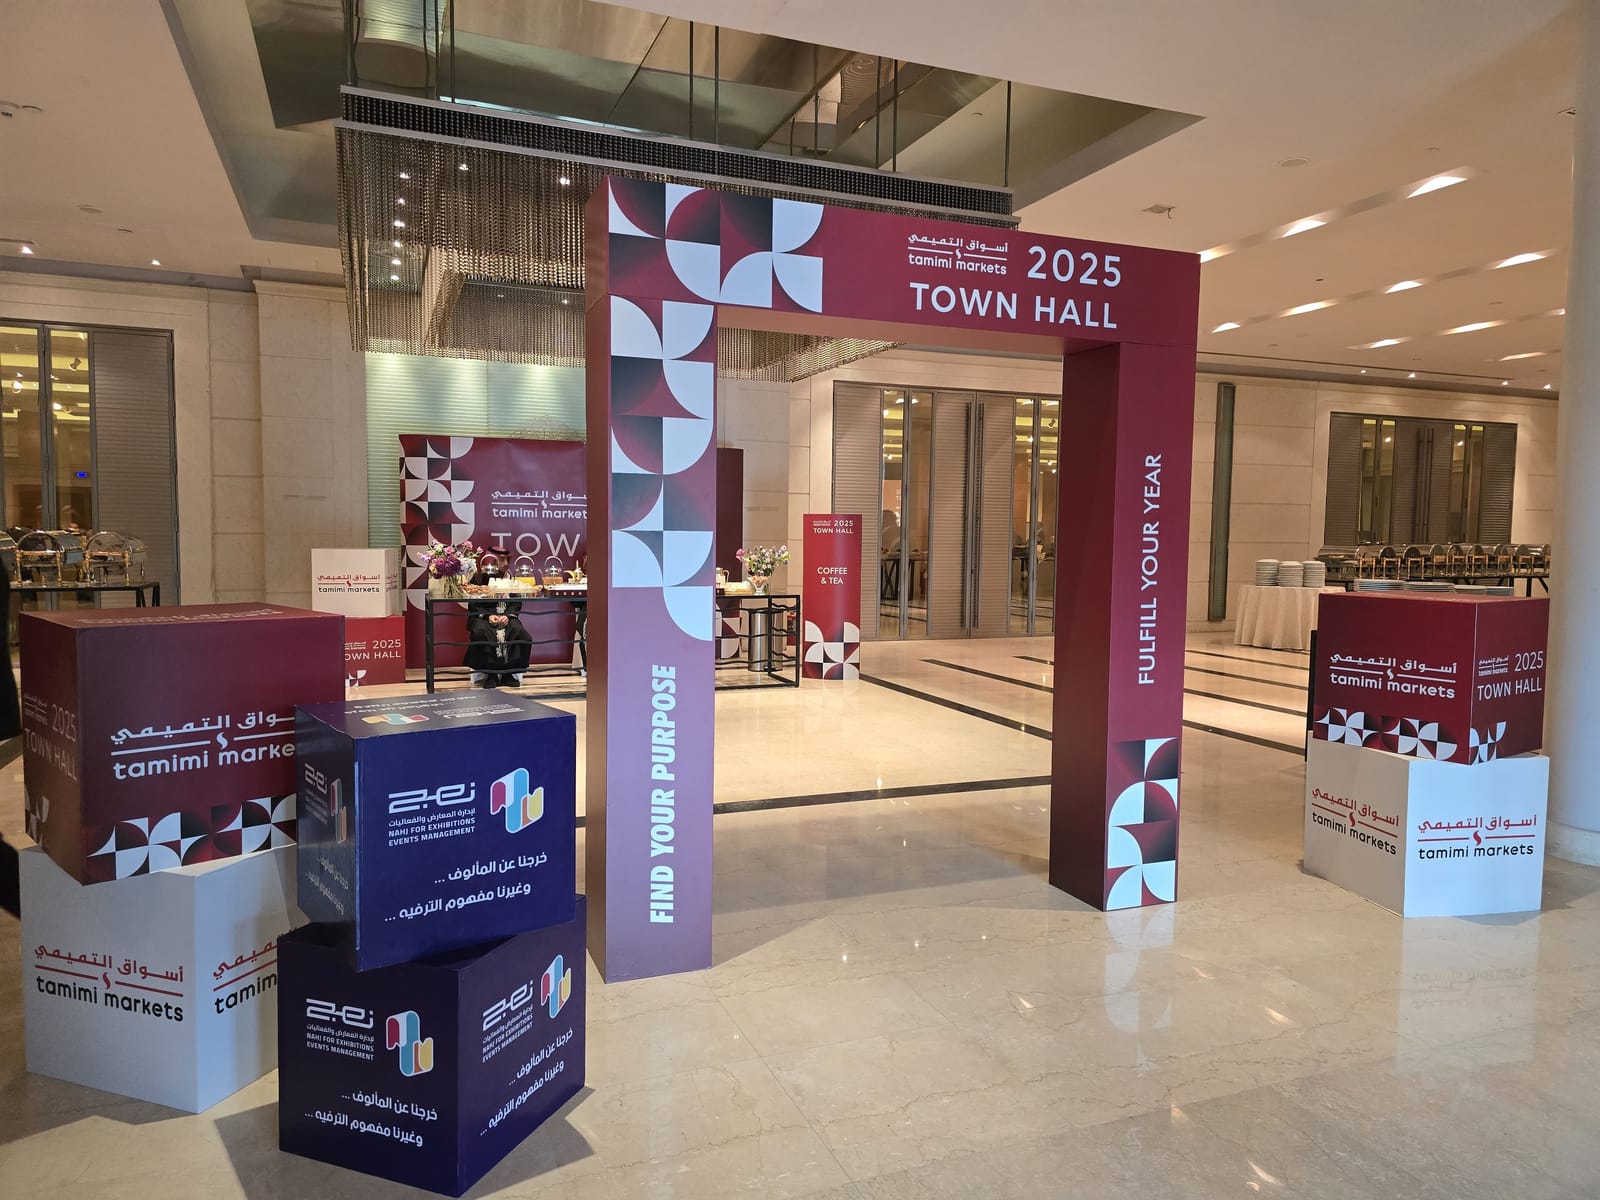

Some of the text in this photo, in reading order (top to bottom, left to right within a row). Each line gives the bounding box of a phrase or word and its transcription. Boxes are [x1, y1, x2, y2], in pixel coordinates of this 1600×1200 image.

[908, 234, 1008, 253] أسواق التميمي
[908, 253, 1007, 275] tamimi markets
[1027, 245, 1121, 288] 2025
[909, 281, 1118, 329] TOWN HALL
[491, 490, 549, 500] التميمي
[492, 507, 588, 520] tamimi market
[490, 532, 581, 557] TOW
[817, 566, 848, 575] COFFEE
[1138, 453, 1162, 685] FULFILL YOUR YEAR
[820, 576, 844, 585] & TEA
[372, 638, 401, 649] 2025
[344, 650, 401, 661] OWN HALL
[1330, 653, 1457, 674] أسواق التميمي
[1514, 650, 1544, 672] 2025
[1330, 672, 1455, 699] tamimi markets
[1477, 677, 1542, 701] TOWN HALL
[52, 703, 77, 742] 2025
[110, 711, 296, 745] واق التميمي
[24, 727, 78, 783] TOWN HALL
[113, 742, 296, 780] tamimi marke
[650, 664, 677, 924] FIND YOUR PURPOSE
[410, 825, 426, 834] FOR
[428, 817, 476, 831] EXHIBITIONS
[1312, 811, 1397, 856] tamimi markets
[1418, 814, 1537, 834] أسواق التميمي
[388, 826, 476, 847] EVENTS MANAGEMENT
[518, 851, 548, 868] خرجنا
[1418, 844, 1534, 860] tamimi markets
[448, 860, 496, 881] المألوف
[498, 859, 516, 873] عن
[445, 889, 494, 911] مفهوم
[497, 882, 532, 899] وغيرنا
[399, 898, 443, 919] الترفيه
[34, 945, 184, 982] أسواق التميمي
[213, 941, 278, 981] ميمي
[36, 975, 184, 1022] tamimi markets
[214, 973, 277, 1015] tamim
[306, 1041, 374, 1061] EVENTS MANAGEMENT
[322, 1035, 335, 1044] FOR
[336, 1038, 374, 1052] EXHIBITIONS
[352, 1091, 392, 1110] المألوف
[394, 1100, 409, 1114] عن
[315, 1110, 349, 1126] الترفيه
[410, 1103, 438, 1121] خرجنا
[350, 1119, 391, 1137] مفهوم
[392, 1126, 423, 1148] وغيرنا
